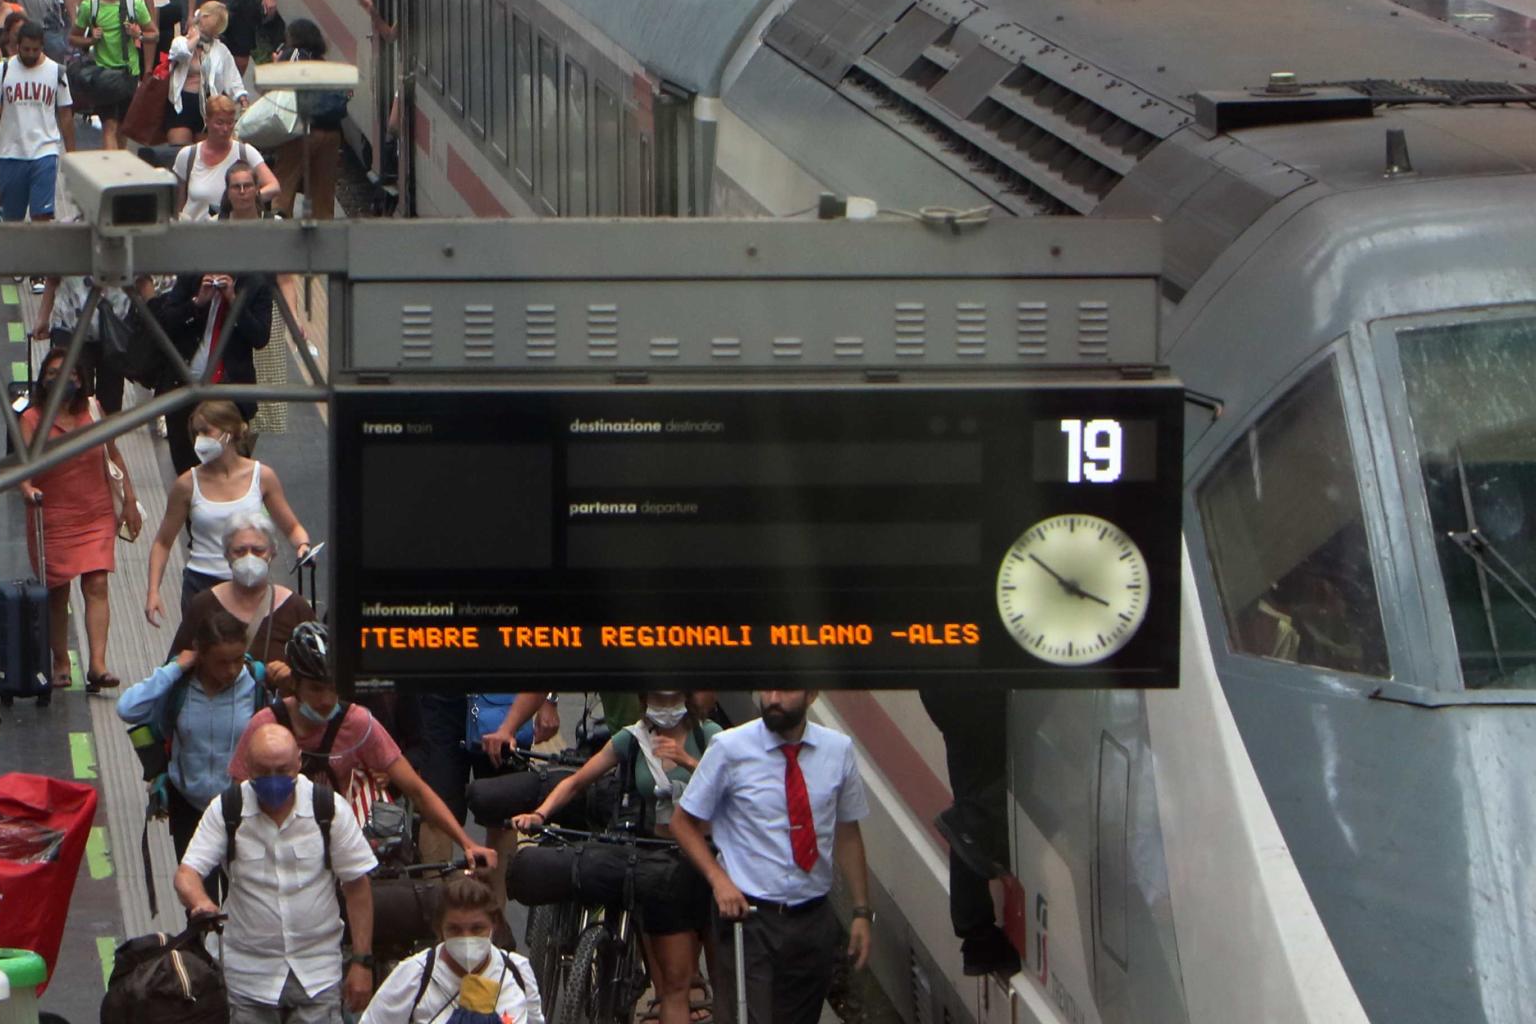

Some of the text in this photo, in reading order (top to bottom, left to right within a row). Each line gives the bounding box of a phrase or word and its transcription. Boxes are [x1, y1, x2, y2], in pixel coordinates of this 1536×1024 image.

[5, 80, 54, 107] CALVIN
[363, 421, 432, 434] treno train
[570, 419, 724, 433] destinazione destination
[1061, 419, 1122, 483] 19
[569, 502, 698, 516] partenza departure
[363, 602, 518, 616] informazioni information
[499, 626, 582, 648] TRENI
[601, 625, 752, 647] REGIONALI
[770, 624, 873, 646] MILANO
[891, 623, 980, 645] -ALES
